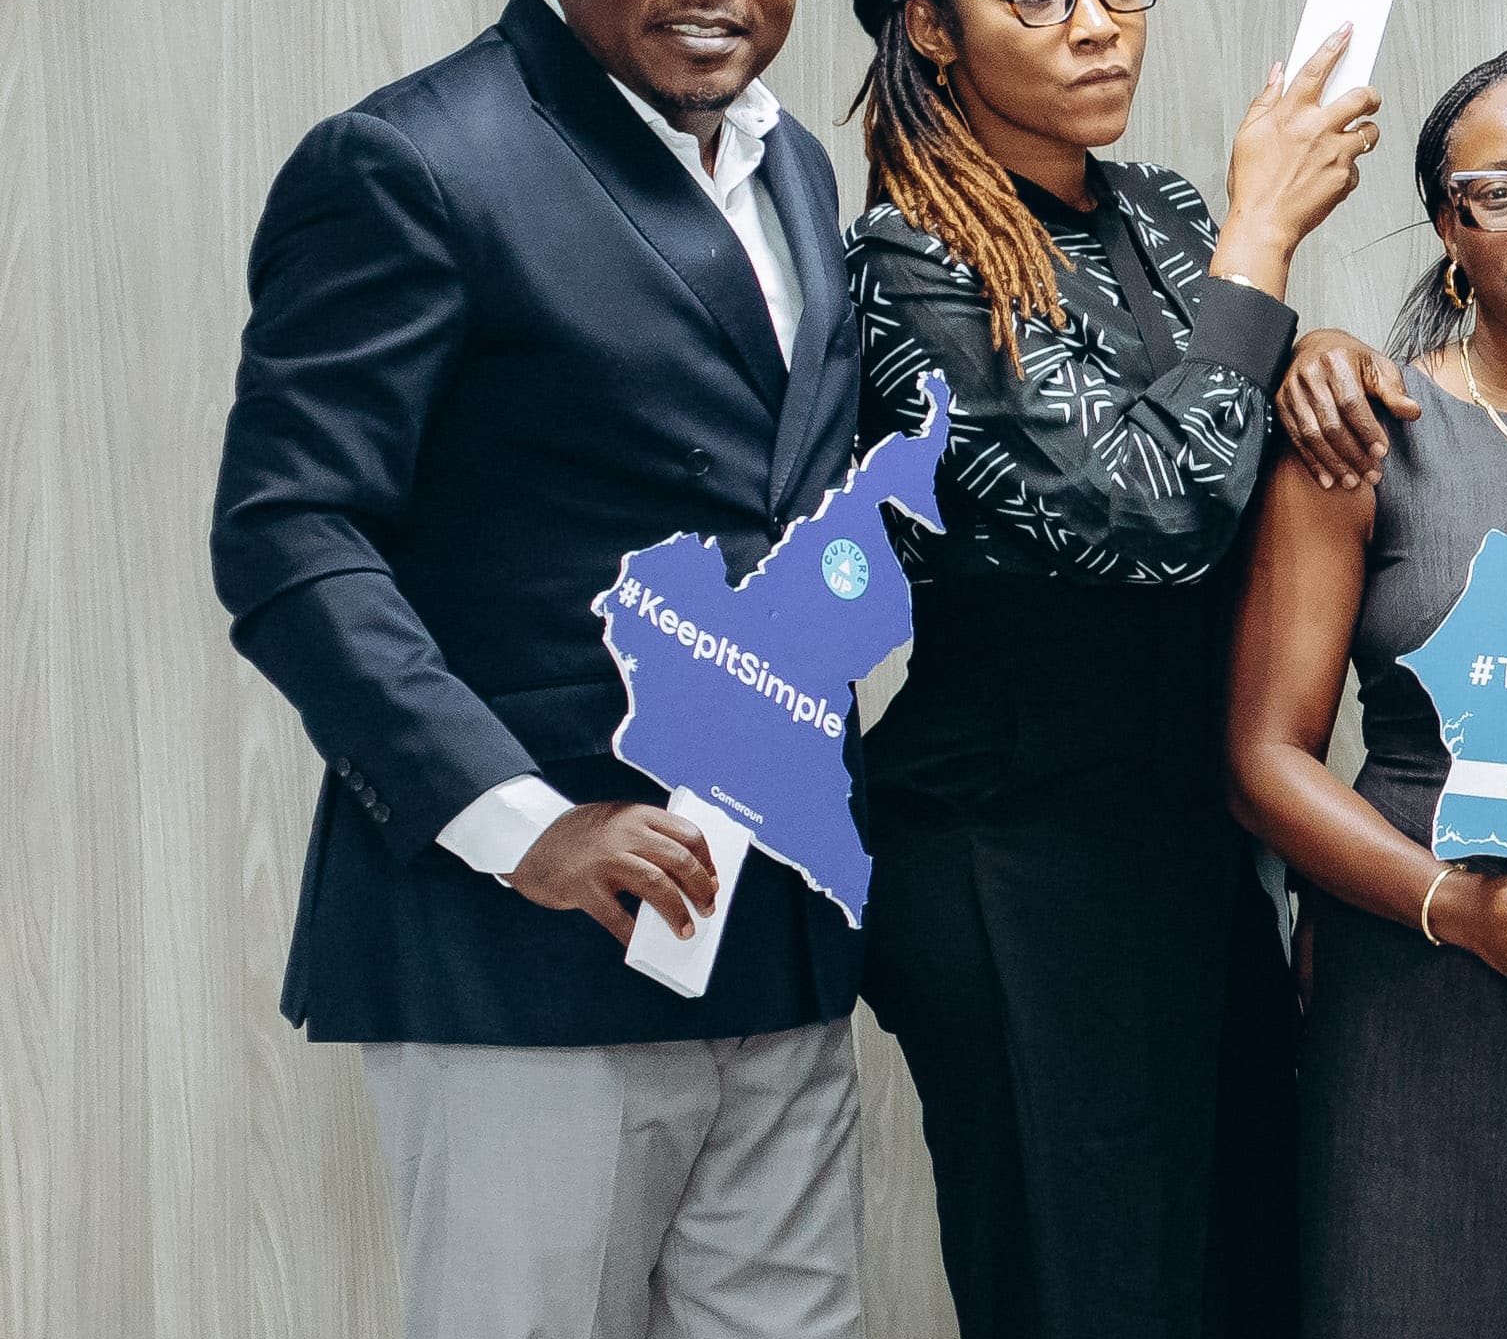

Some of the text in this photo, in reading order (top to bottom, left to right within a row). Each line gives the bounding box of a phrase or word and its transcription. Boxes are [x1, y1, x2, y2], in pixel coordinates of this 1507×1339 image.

[823, 541, 867, 587] CULTURE
[830, 571, 853, 595] UP
[617, 577, 845, 738] #KeepItSimple
[710, 785, 764, 825] Cameroun
